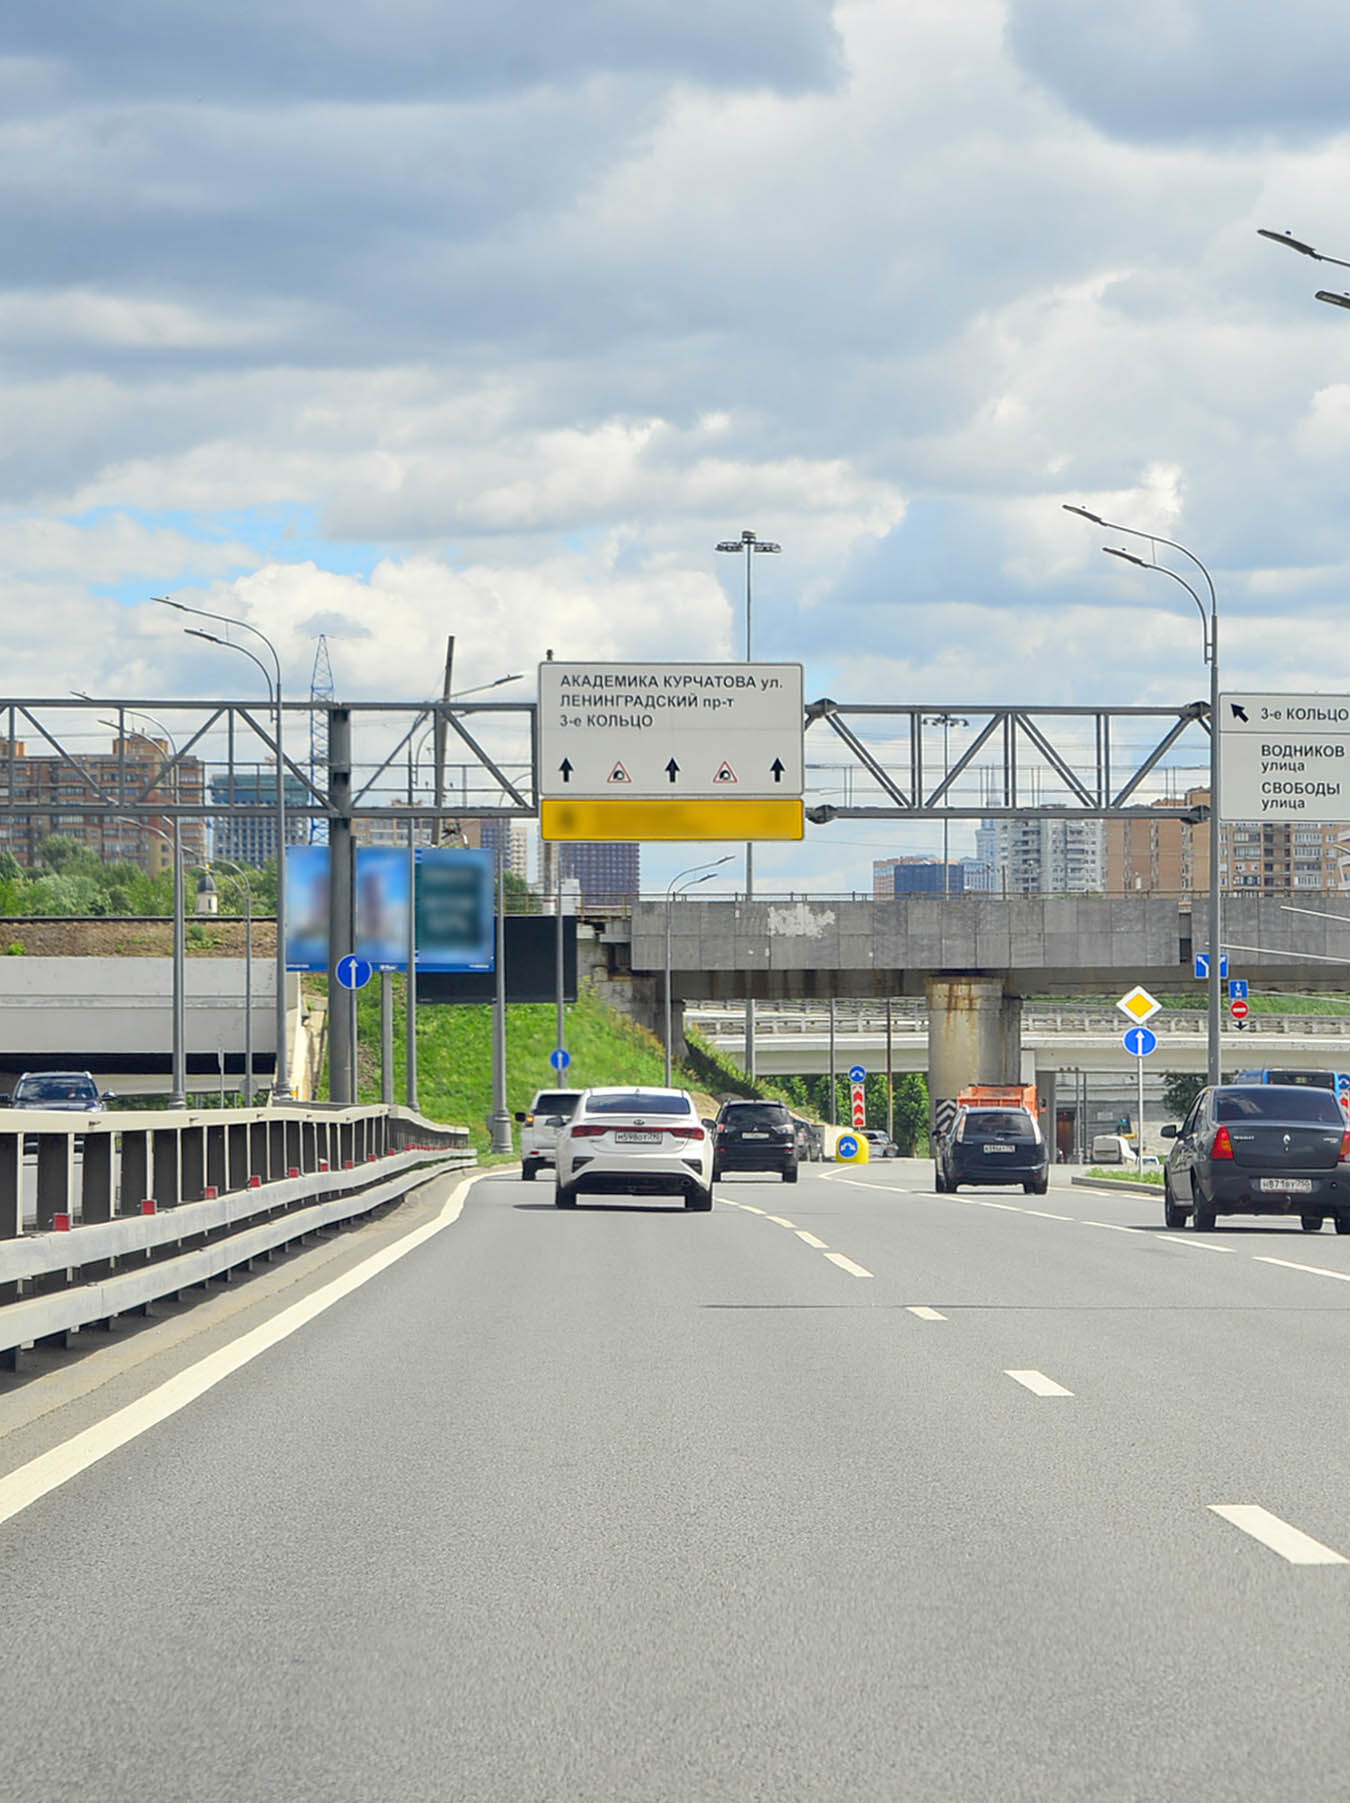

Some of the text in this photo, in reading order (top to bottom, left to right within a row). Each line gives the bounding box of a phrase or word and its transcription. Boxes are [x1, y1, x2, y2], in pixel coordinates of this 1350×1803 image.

[560, 674, 784, 693] АКАДЕМИКА КУРЧАТОВА ул.
[560, 692, 735, 711] ЛЕНИНГРАДСКИЙ пр-т
[559, 714, 653, 731] 3-е КОЛЬЦО
[1260, 707, 1282, 721] 3-е
[1286, 707, 1349, 723] КОЛЬЦО
[1261, 744, 1345, 759] ВОДНИКОВ
[1261, 761, 1305, 774] улица
[1261, 781, 1341, 797] СВОБОДЫ
[1261, 799, 1305, 812] улица
